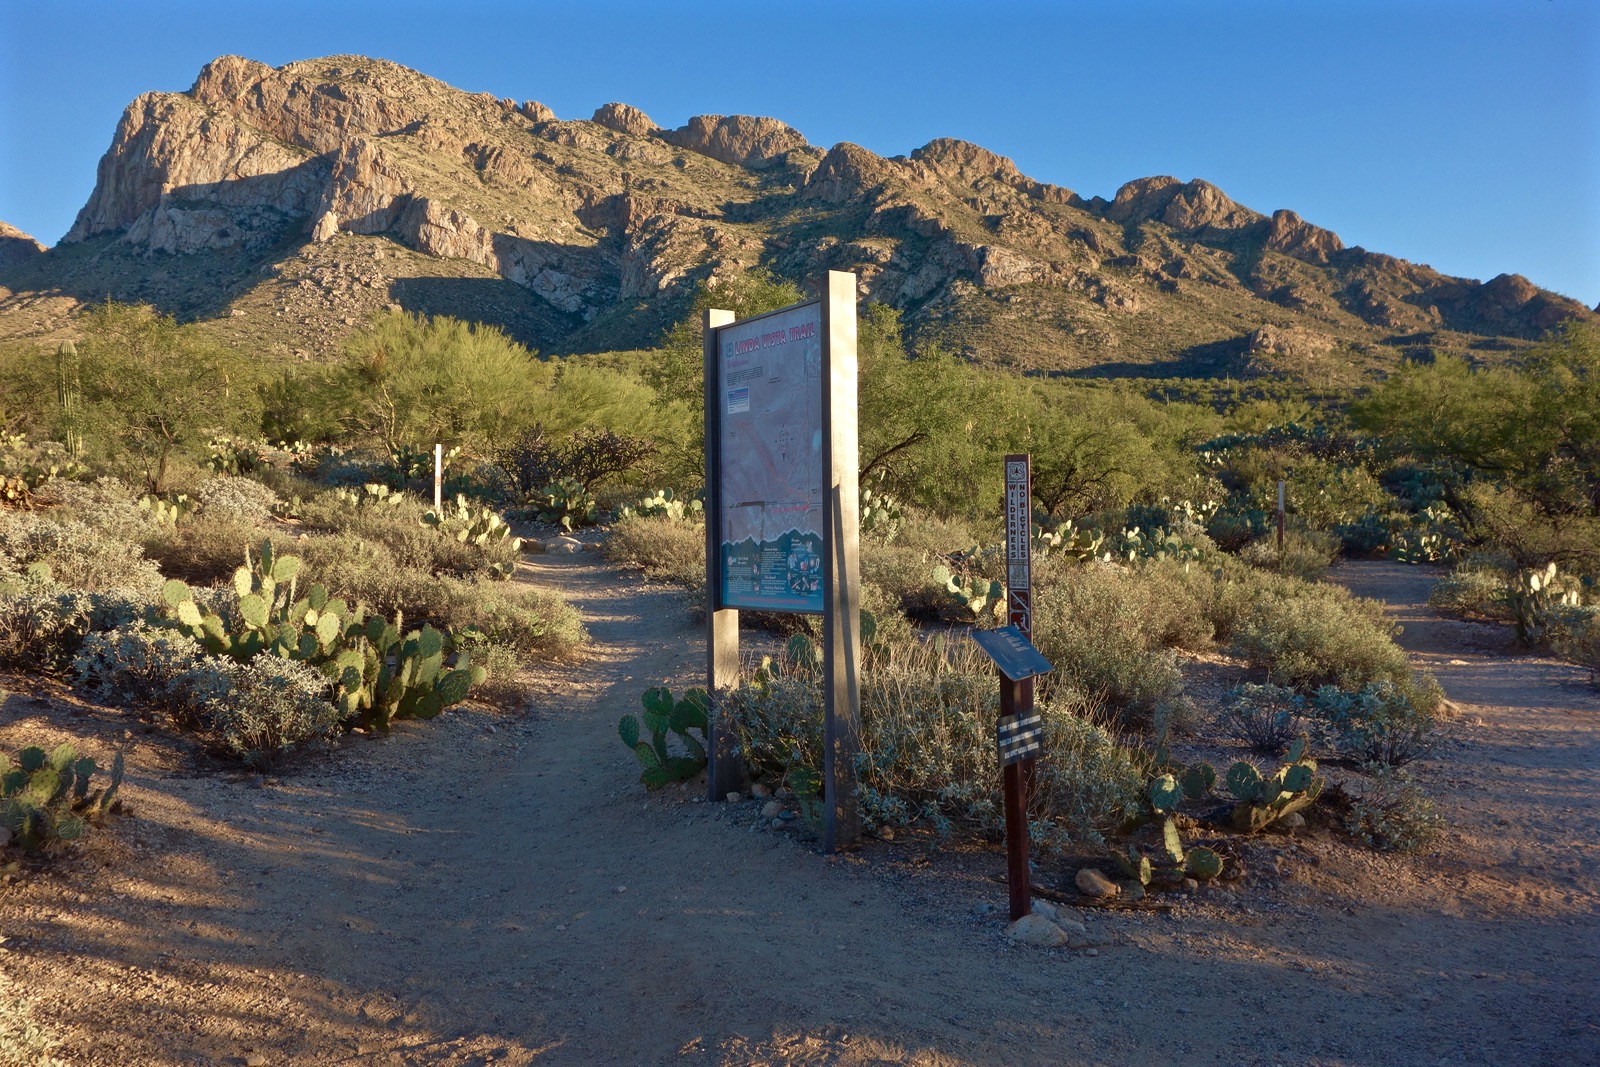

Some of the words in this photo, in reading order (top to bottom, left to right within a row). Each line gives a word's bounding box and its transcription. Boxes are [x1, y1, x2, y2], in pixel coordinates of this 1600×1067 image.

[735, 337, 760, 356] LINDA
[762, 330, 787, 348] VISTA
[789, 322, 815, 342] TRAIL
[1020, 484, 1026, 498] NO
